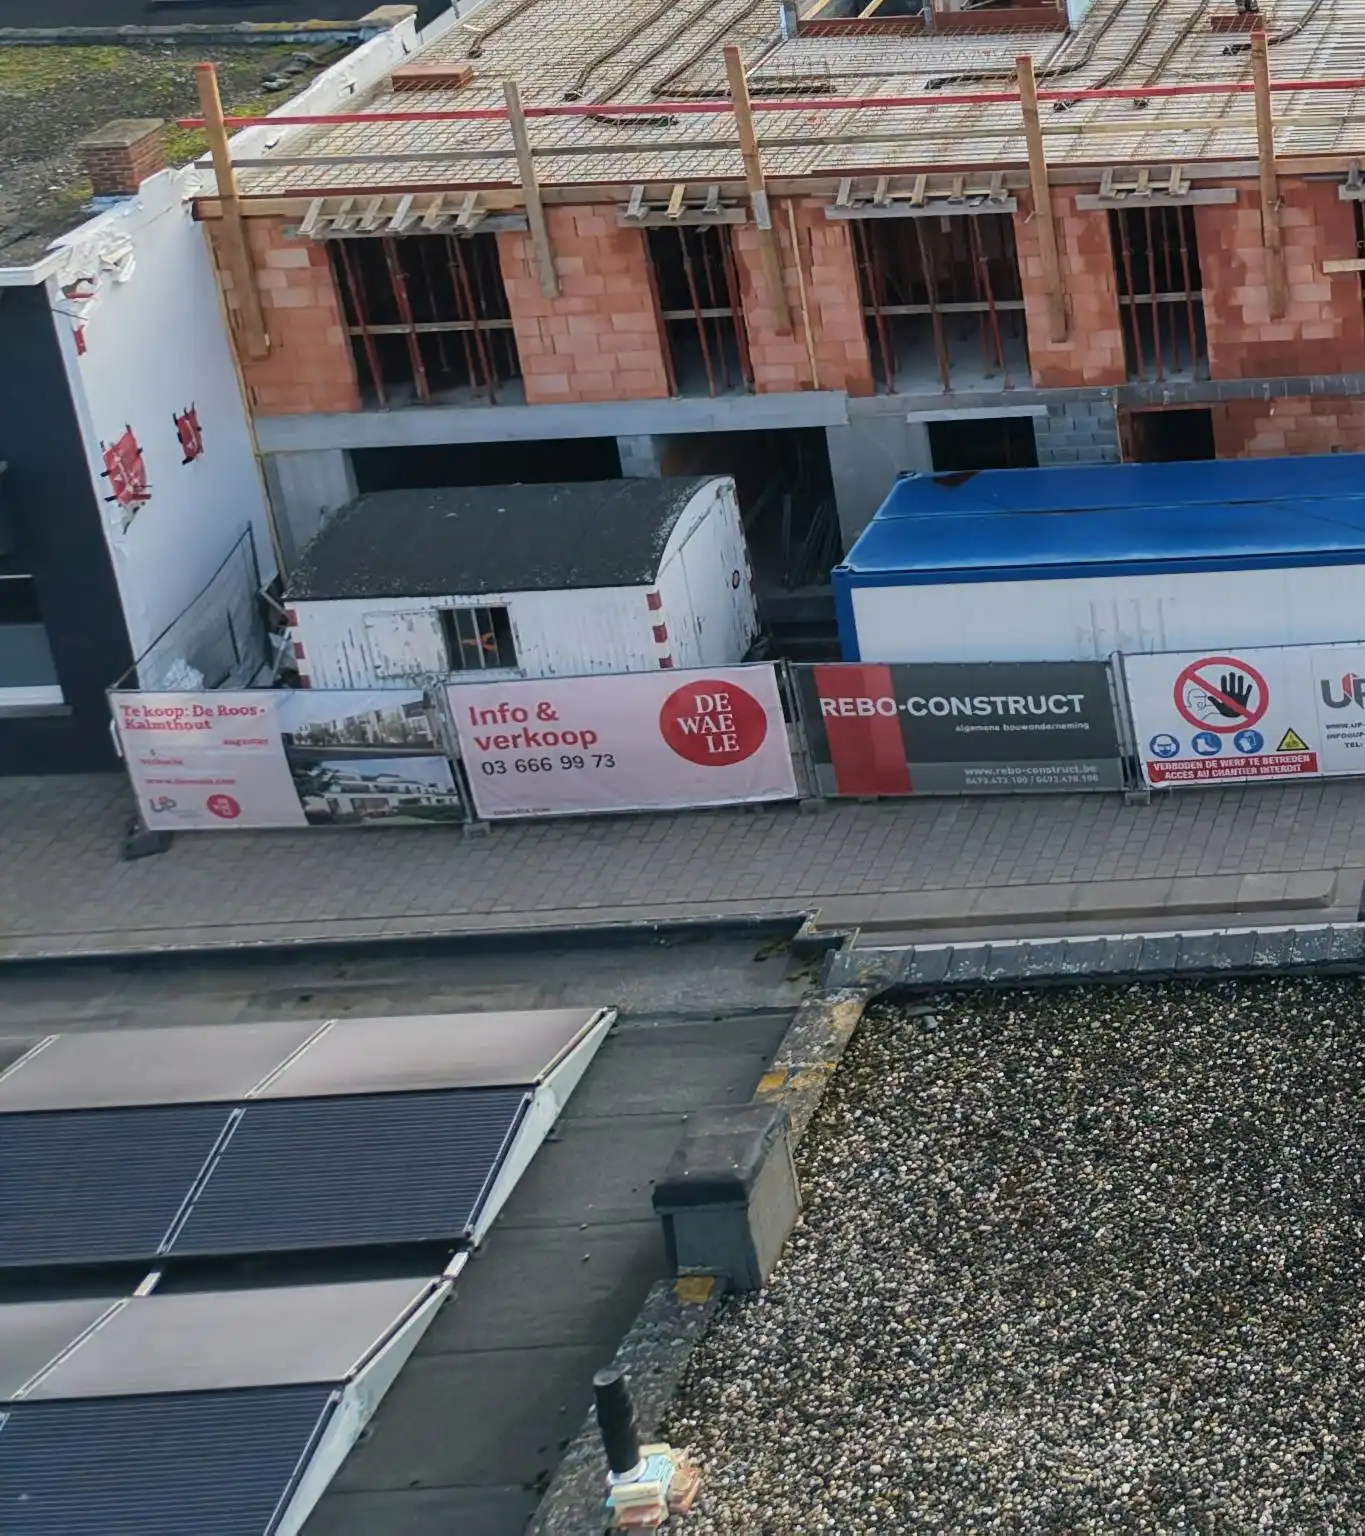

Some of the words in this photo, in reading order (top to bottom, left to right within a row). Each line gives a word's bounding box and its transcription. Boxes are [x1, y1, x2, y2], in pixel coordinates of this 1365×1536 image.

[120, 705, 140, 717] Te
[142, 705, 188, 720] koop:
[193, 704, 214, 717] De
[217, 704, 257, 716] Roos
[694, 692, 730, 714] DE
[820, 694, 1084, 717] REBO-CONSTRUCT
[125, 718, 212, 730] Kalmthout
[469, 702, 529, 726] Info
[536, 702, 560, 722] &
[677, 714, 736, 736] WAE
[956, 724, 1000, 732] algemene
[1003, 722, 1090, 732] bouwonderneming
[474, 727, 598, 752] verkoop
[706, 734, 740, 754] LE
[481, 760, 507, 776] 03
[514, 757, 552, 773] 666
[560, 755, 584, 770] 99
[592, 754, 616, 768] 73
[1153, 758, 1202, 771] VERBODEN
[1206, 758, 1219, 768] DE
[1220, 756, 1246, 768] WERF
[1250, 756, 1261, 766] TE
[1262, 754, 1310, 766] BETREDEN
[1197, 768, 1212, 778] AU
[1212, 766, 1258, 778] CHANTIER
[1260, 764, 1302, 775] INTERDIT
